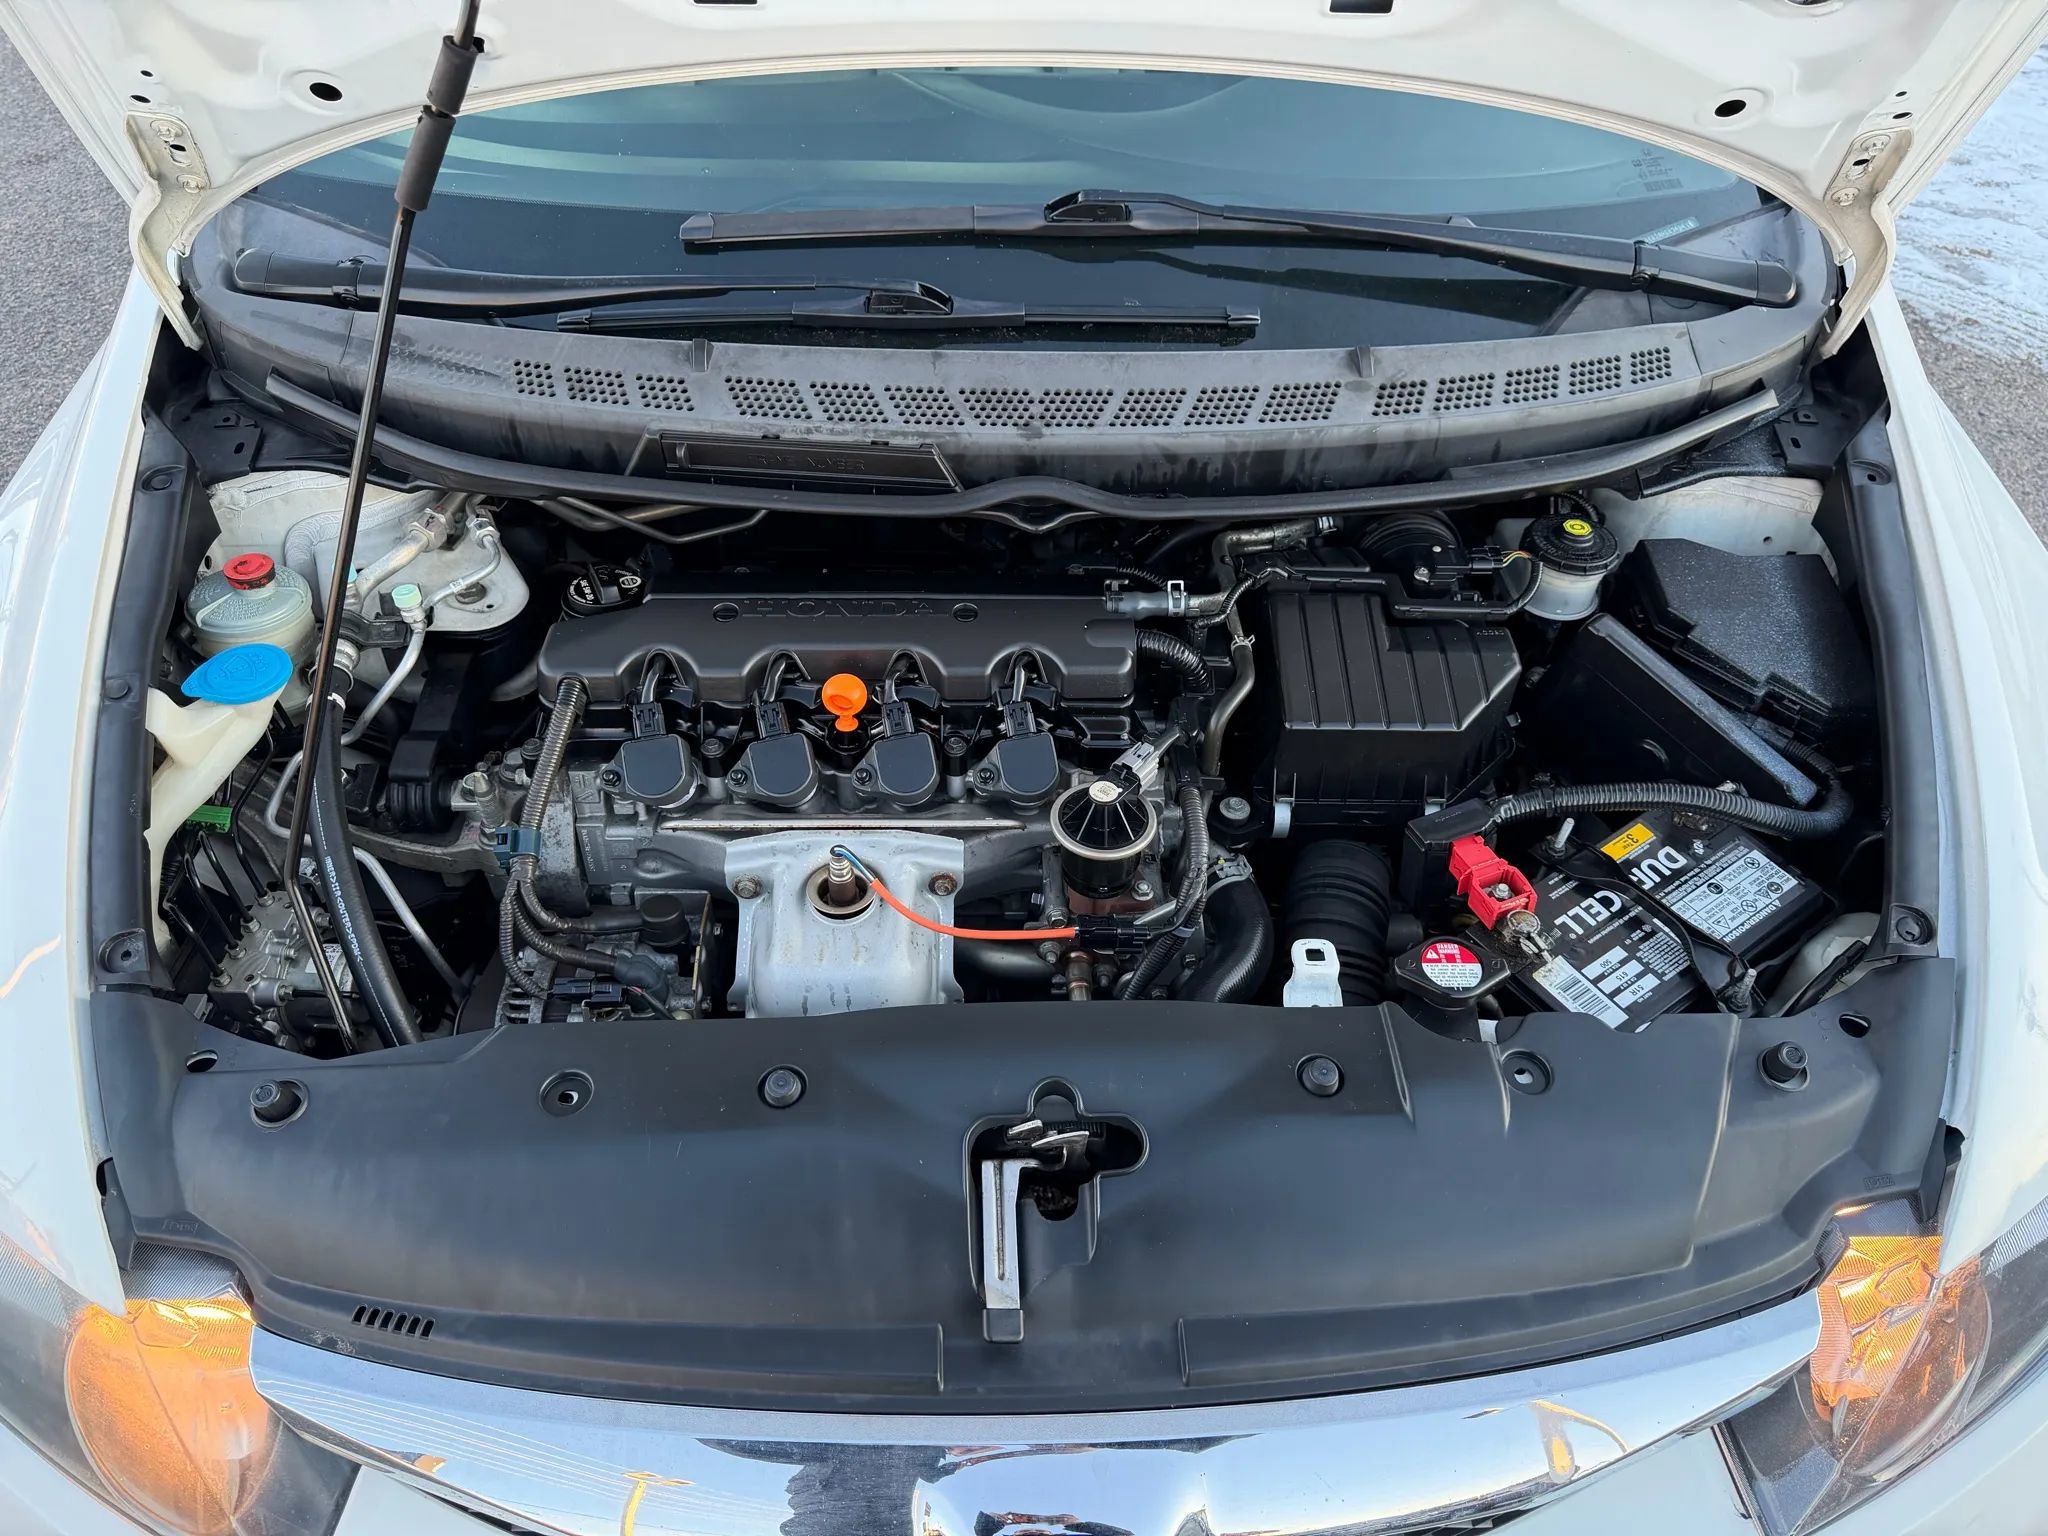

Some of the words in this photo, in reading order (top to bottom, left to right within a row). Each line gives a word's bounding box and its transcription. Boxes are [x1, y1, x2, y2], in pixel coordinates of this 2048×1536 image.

[1626, 833, 1639, 844] 3
[1723, 904, 1777, 943] DANGER/POISON
[1600, 959, 1613, 969] 500
[1616, 971, 1629, 981] 615
[1629, 984, 1644, 996] 51R
